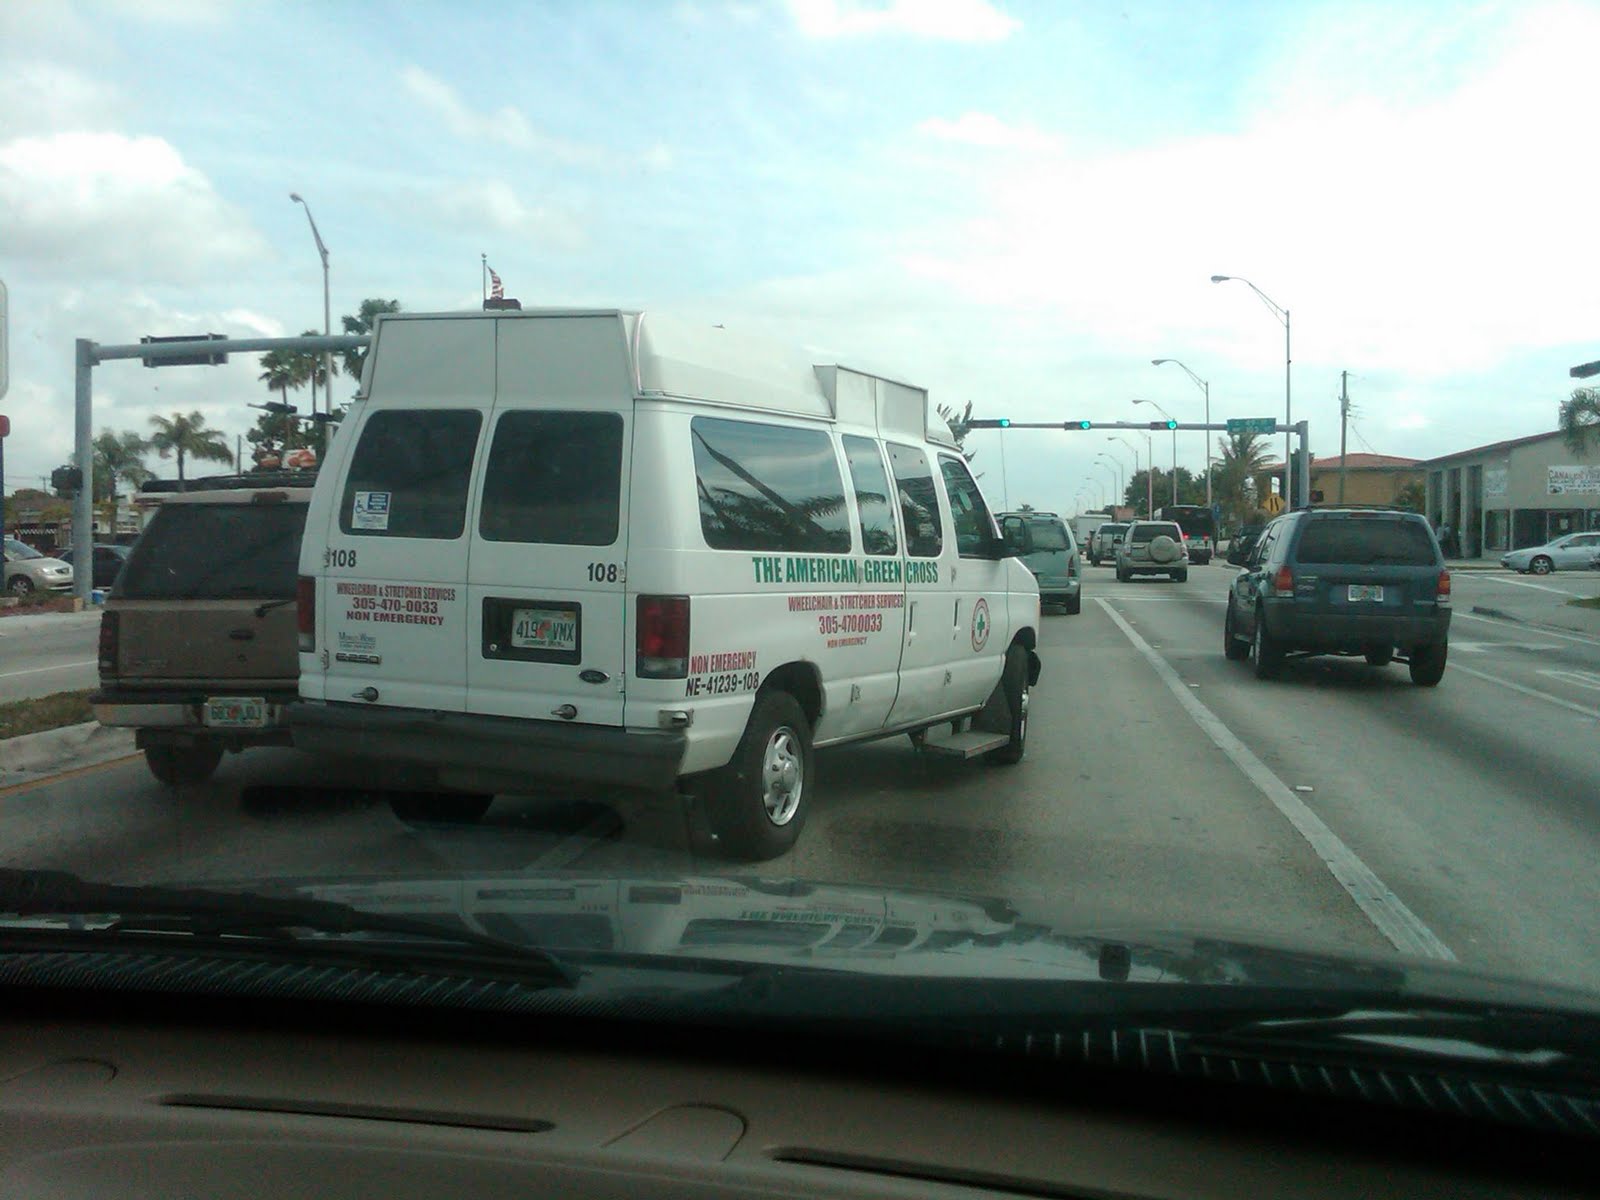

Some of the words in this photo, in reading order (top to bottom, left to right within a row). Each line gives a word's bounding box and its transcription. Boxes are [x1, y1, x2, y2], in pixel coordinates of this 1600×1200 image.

[331, 549, 357, 567] 108
[587, 562, 618, 583] 108
[752, 557, 783, 583] THE
[786, 558, 858, 583] AMERICAN
[864, 559, 902, 583] GREEN
[906, 561, 939, 584] CROSS
[336, 582, 378, 597] WHEELCHAIR
[379, 586, 384, 597] &
[385, 585, 423, 600] STRETCHER
[423, 587, 456, 602] SERVICES
[352, 596, 439, 614] 305-470-0033
[788, 595, 833, 612] WHEELCHAIR
[834, 597, 839, 610] &
[840, 595, 876, 610] STRETCHER
[876, 594, 905, 609] SERVICES
[346, 611, 371, 622] NON
[373, 612, 445, 626] EMERGENCY
[516, 619, 538, 639] 419
[553, 622, 575, 642] VMX
[827, 638, 839, 649] NON
[691, 654, 710, 675] NON
[710, 650, 757, 673] EMERGENCY
[685, 671, 760, 697] NE-41239-108
